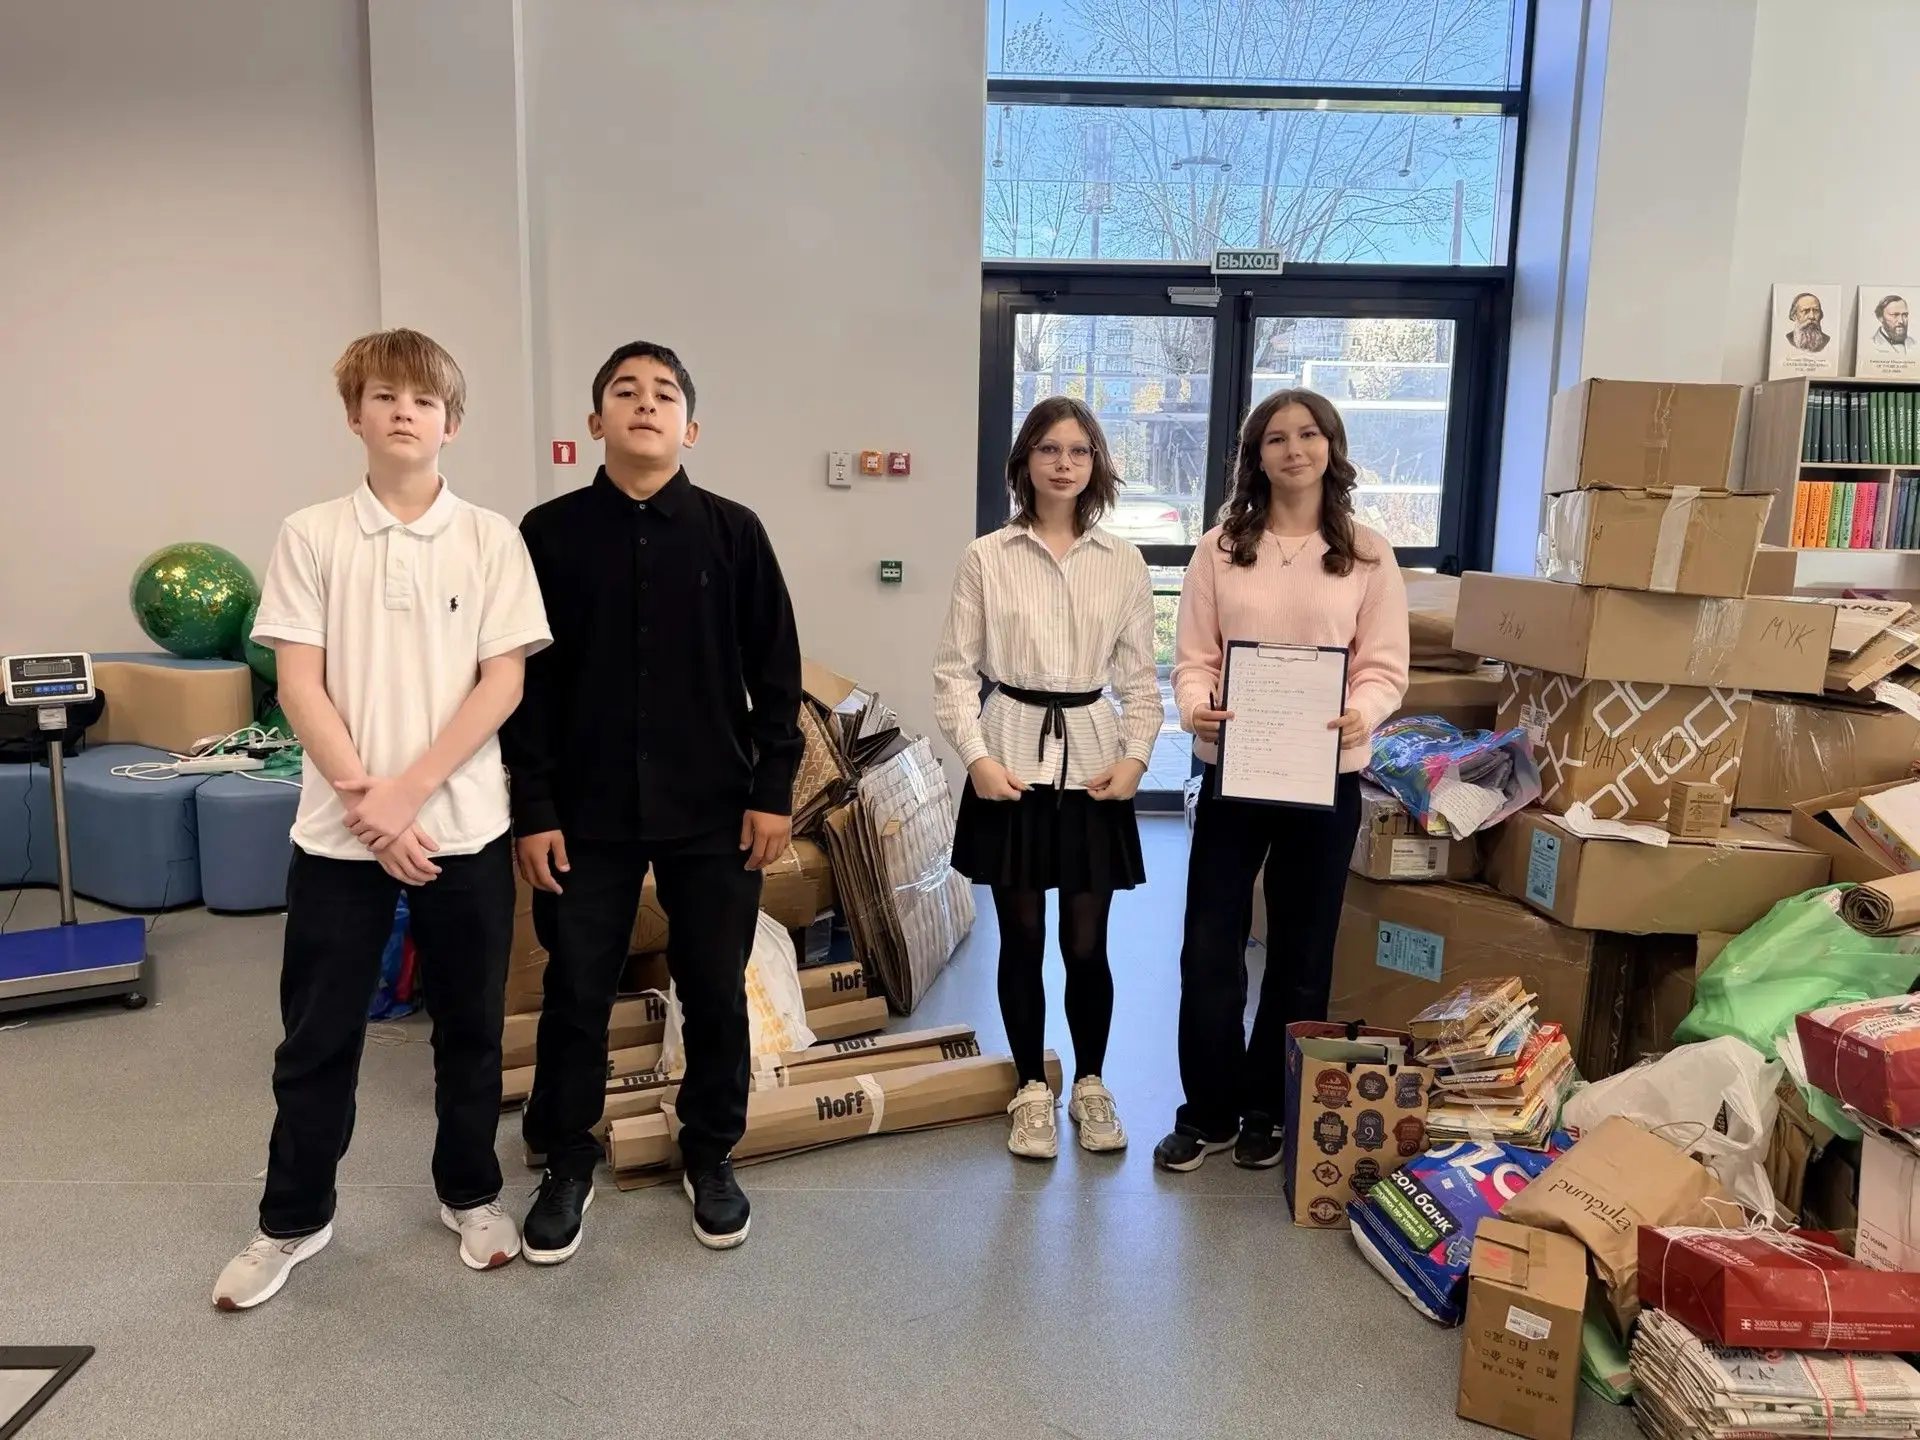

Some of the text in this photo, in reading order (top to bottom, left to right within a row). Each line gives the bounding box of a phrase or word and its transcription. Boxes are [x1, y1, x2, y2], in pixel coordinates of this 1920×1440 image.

[1219, 255, 1277, 269] ВЫХОД
[816, 1090, 865, 1121] Hoff
[1414, 1191, 1454, 1234] банк
[1548, 1178, 1631, 1231] pumpula
